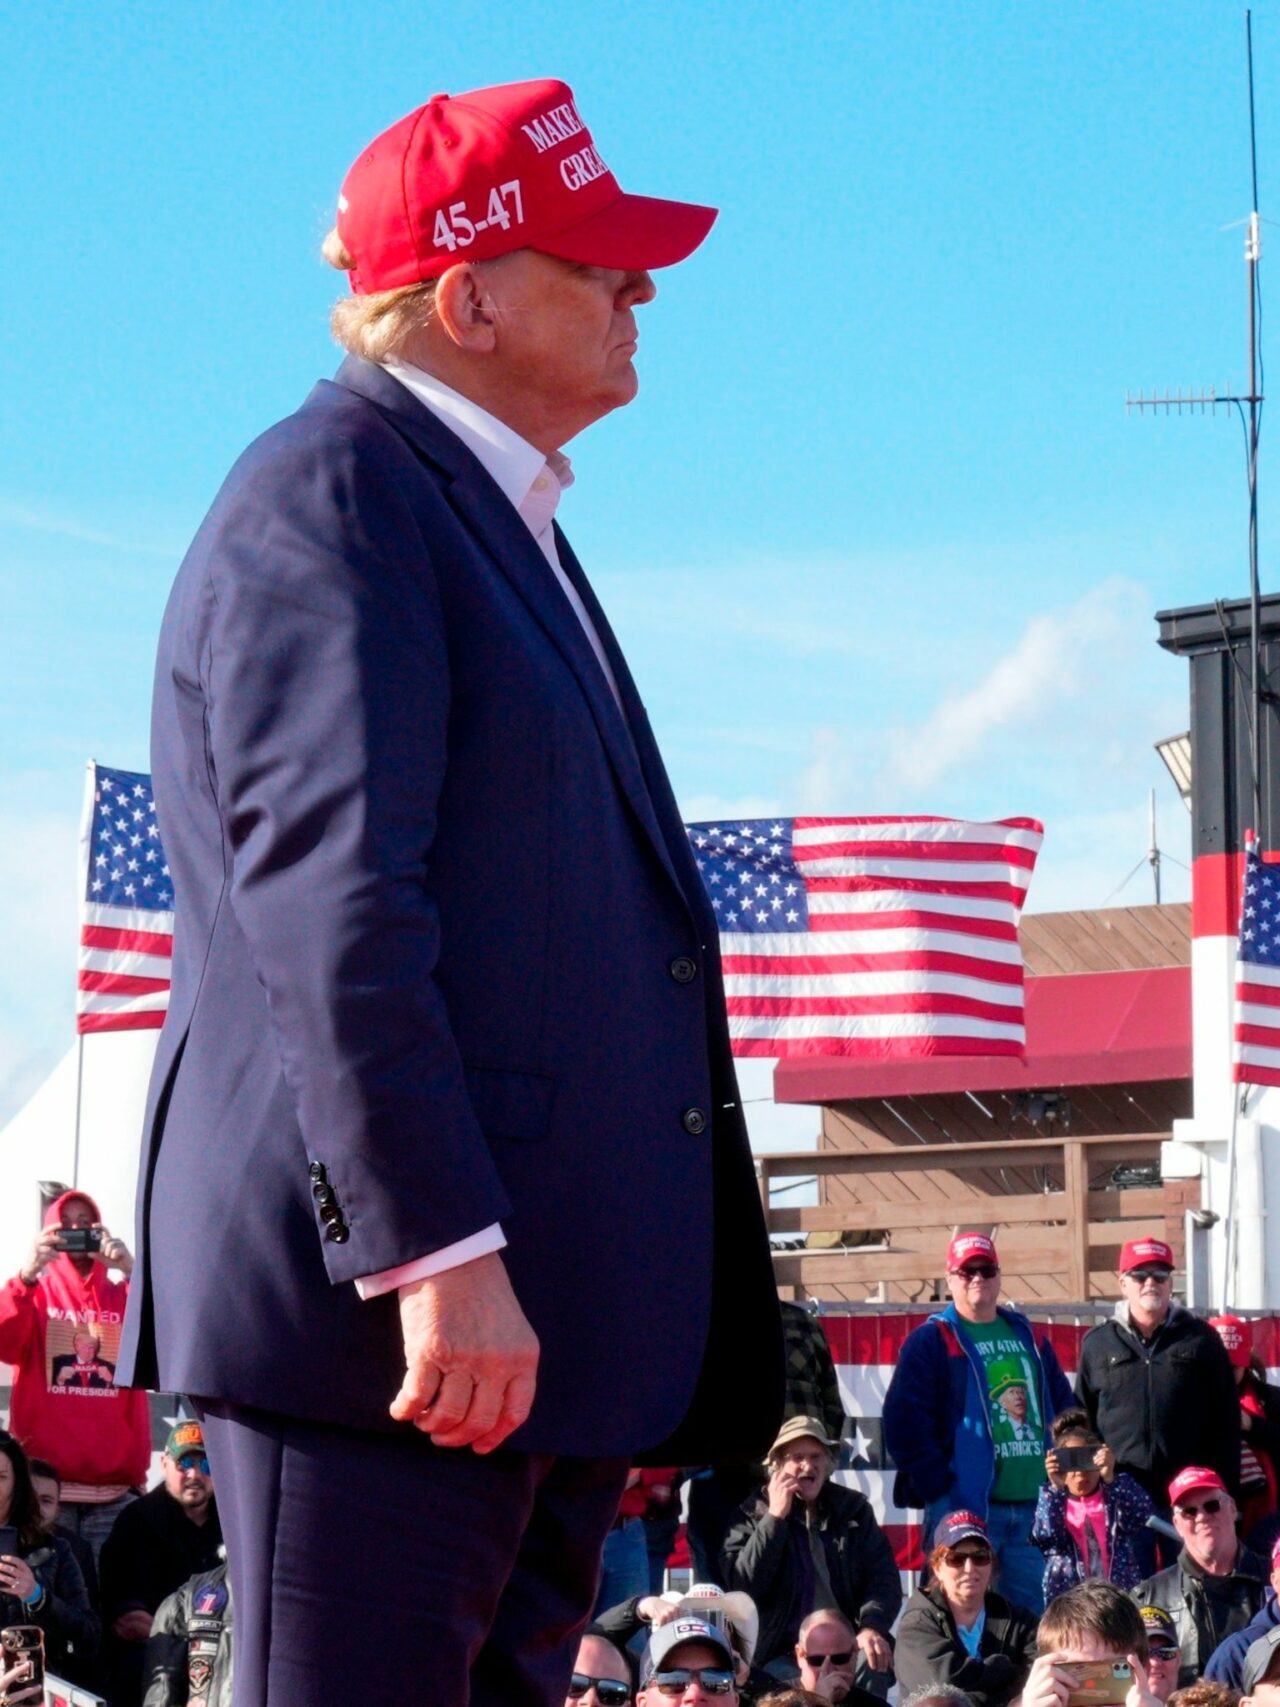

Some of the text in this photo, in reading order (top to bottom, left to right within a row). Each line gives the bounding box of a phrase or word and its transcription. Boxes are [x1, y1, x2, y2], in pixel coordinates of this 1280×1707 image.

[521, 103, 582, 154] MAKE
[433, 179, 524, 252] 45-47
[47, 1307, 120, 1324] WANTED
[997, 1340, 1020, 1353] 4TH
[68, 1386, 119, 1398] PRESIDENT
[993, 1440, 1041, 1460] PATRICK'S
